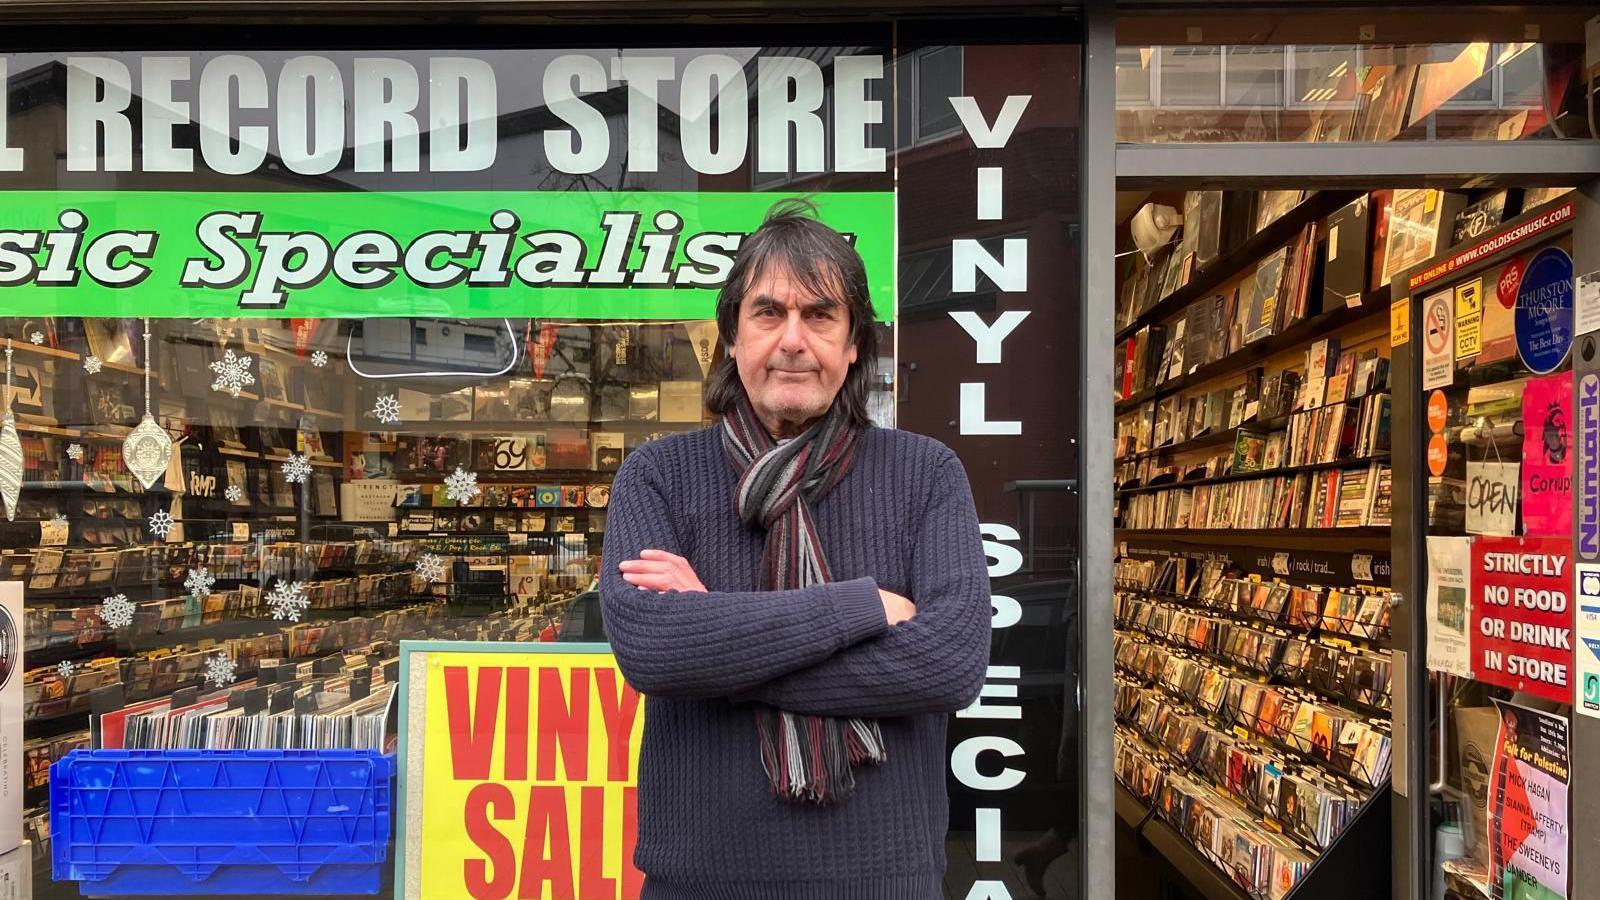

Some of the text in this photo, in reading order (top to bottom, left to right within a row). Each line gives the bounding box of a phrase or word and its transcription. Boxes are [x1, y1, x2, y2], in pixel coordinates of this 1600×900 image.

[66, 55, 498, 174] RECORD
[542, 55, 887, 174] STORE
[179, 208, 857, 309] Specialis
[1410, 273, 1423, 287] BUY
[1423, 263, 1447, 281] ONLINE
[1455, 206, 1571, 266] WWW.COOLDISCSMUSIC.COM
[948, 95, 1032, 435] VINYL
[1500, 266, 1518, 295] PRS
[1520, 280, 1573, 308] THURSTON
[1528, 295, 1564, 319] MOORE
[1458, 315, 1479, 328] WARNING
[1460, 335, 1477, 349] CCTV
[495, 439, 526, 470] 69
[1581, 381, 1597, 553] Numark
[1468, 475, 1516, 517] OPEN
[1530, 474, 1572, 496] Corrup
[1296, 559, 1310, 572] rock
[1374, 561, 1390, 575] irish
[1483, 552, 1567, 576] STRICTLY
[1484, 585, 1567, 613] NO FOOD
[1480, 617, 1571, 650] OR DRINK
[1484, 650, 1502, 669] IN
[1507, 654, 1567, 686] STORE
[444, 666, 641, 782] VINY
[1504, 740, 1518, 756] Folk
[1520, 747, 1533, 762] for
[1534, 753, 1567, 778] Palestine
[1508, 774, 1550, 802] MICK HAGAN
[1506, 797, 1563, 834] SIANNA LAFFERTY
[1521, 818, 1547, 844] (TRAMP)
[1503, 833, 1560, 875] THE SWEENEYS
